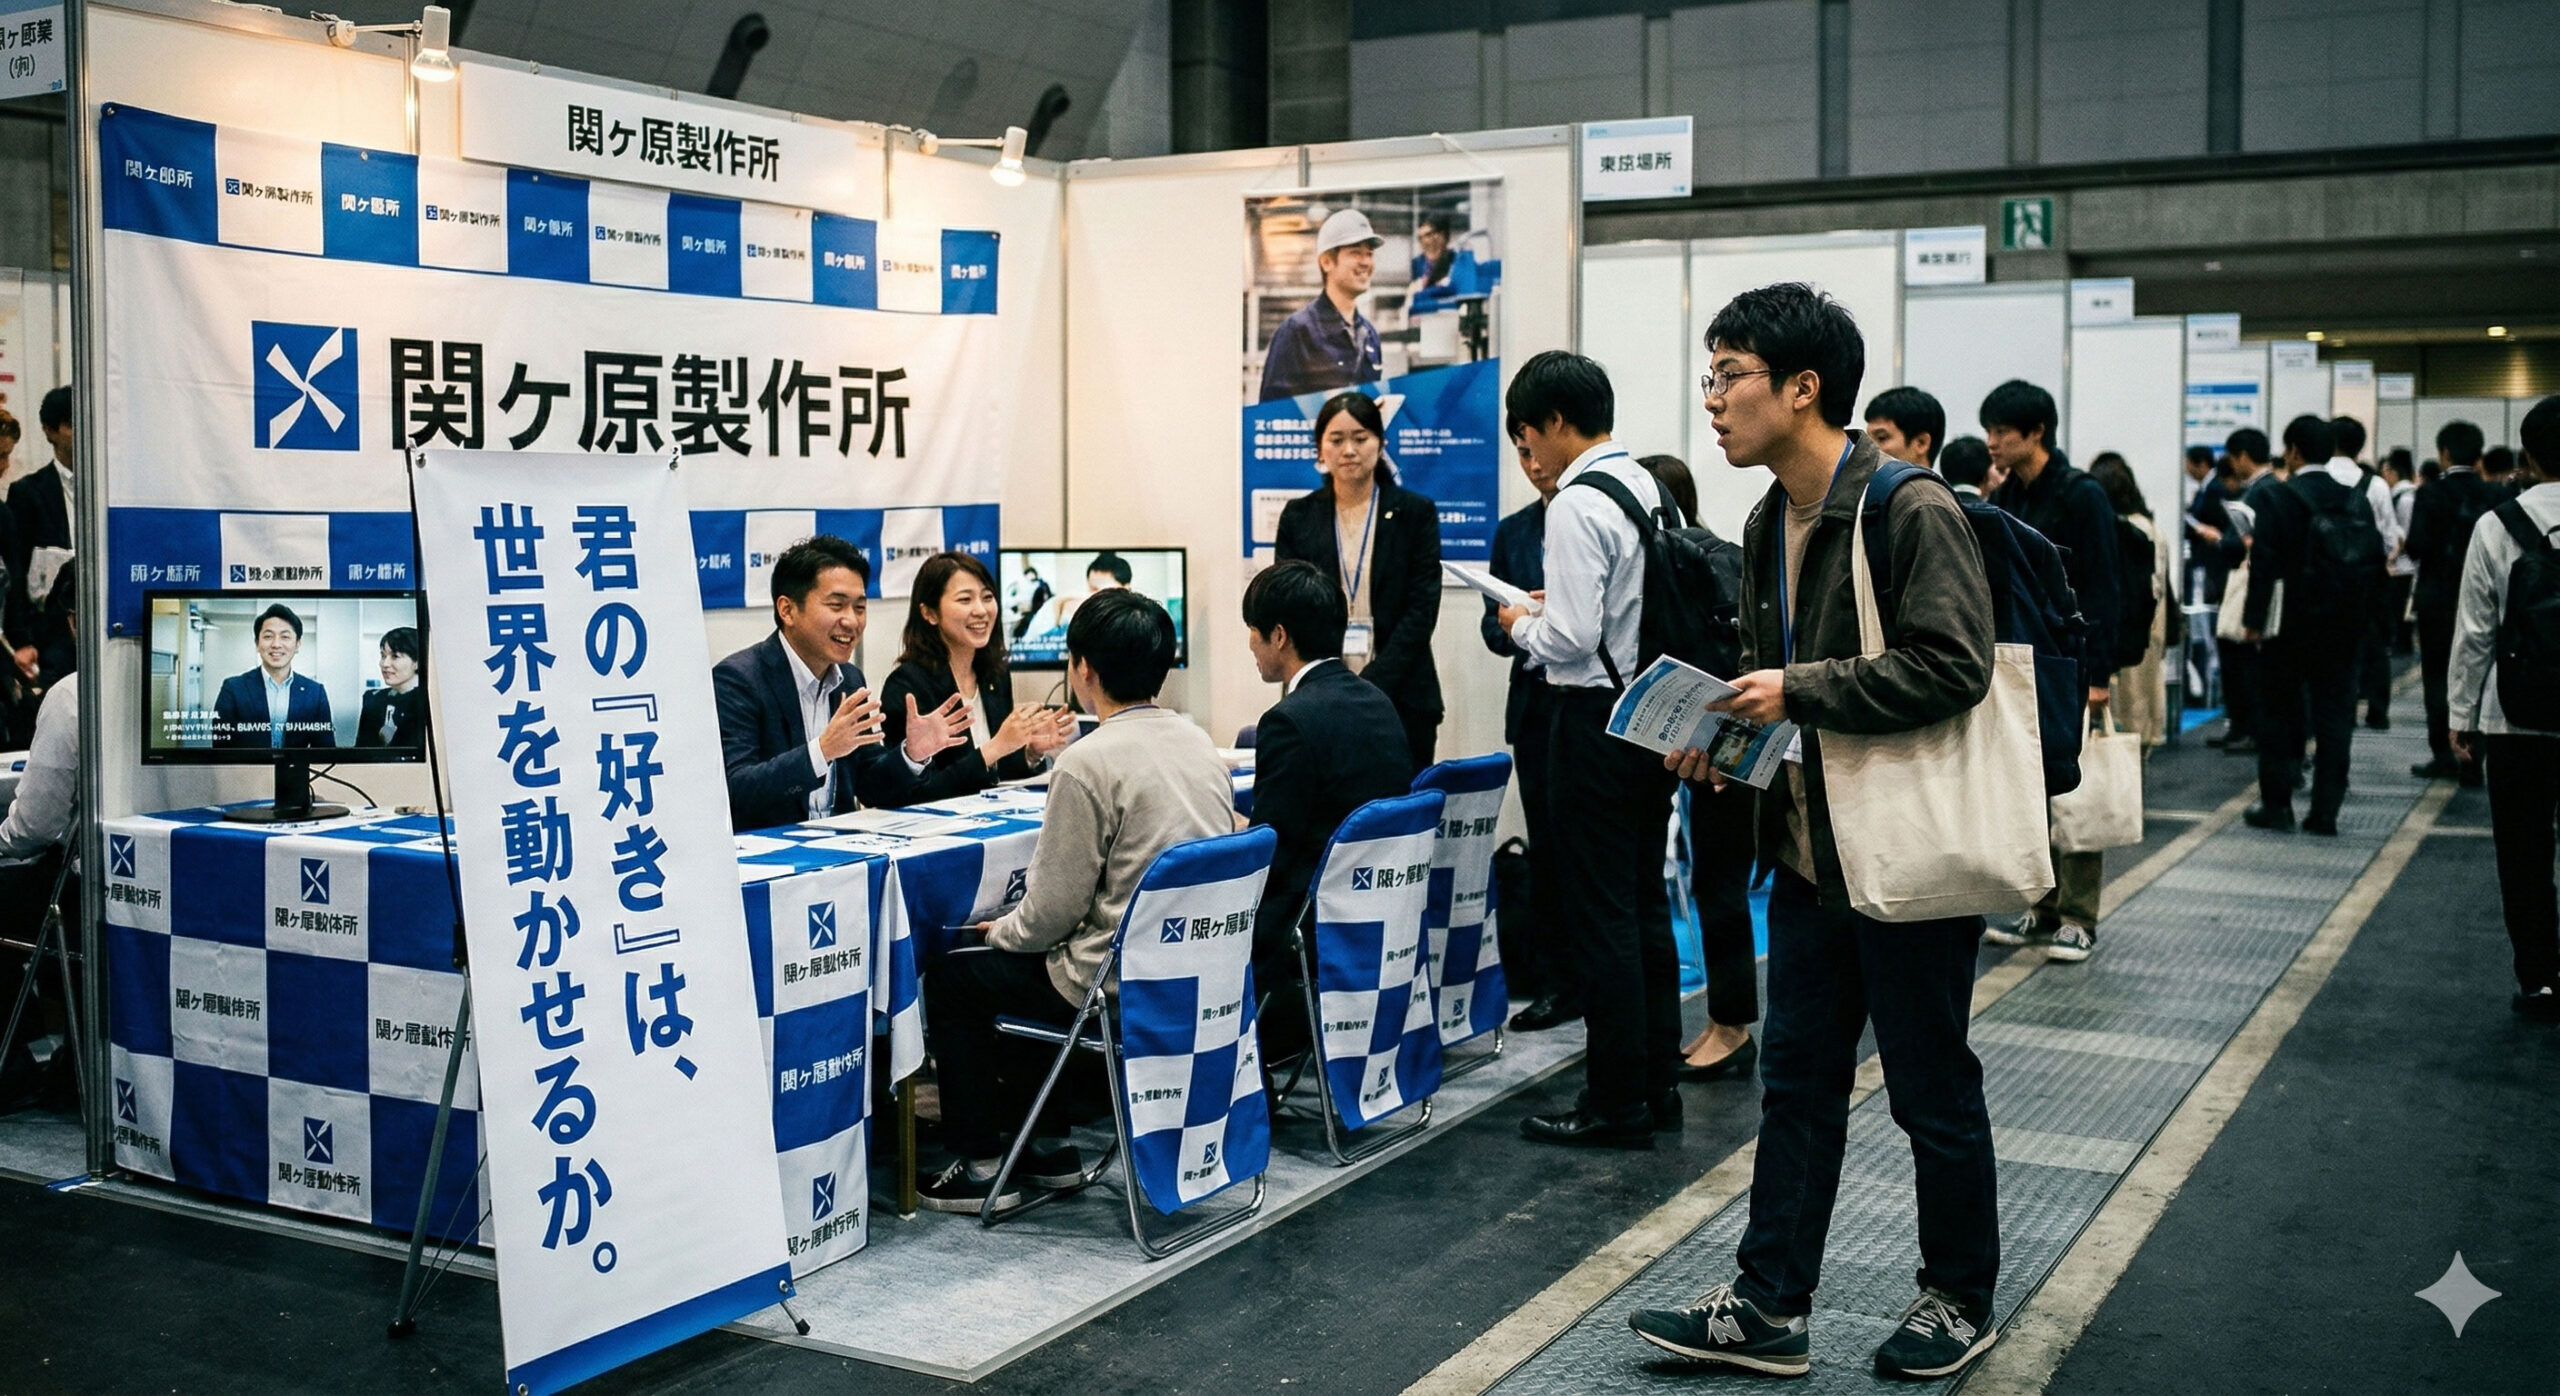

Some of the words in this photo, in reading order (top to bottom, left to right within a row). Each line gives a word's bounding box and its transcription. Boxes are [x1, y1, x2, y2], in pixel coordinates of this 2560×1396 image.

[473, 502, 618, 1275] 世界を動かせるか。
[572, 504, 698, 1080] 君の『好き』は、
